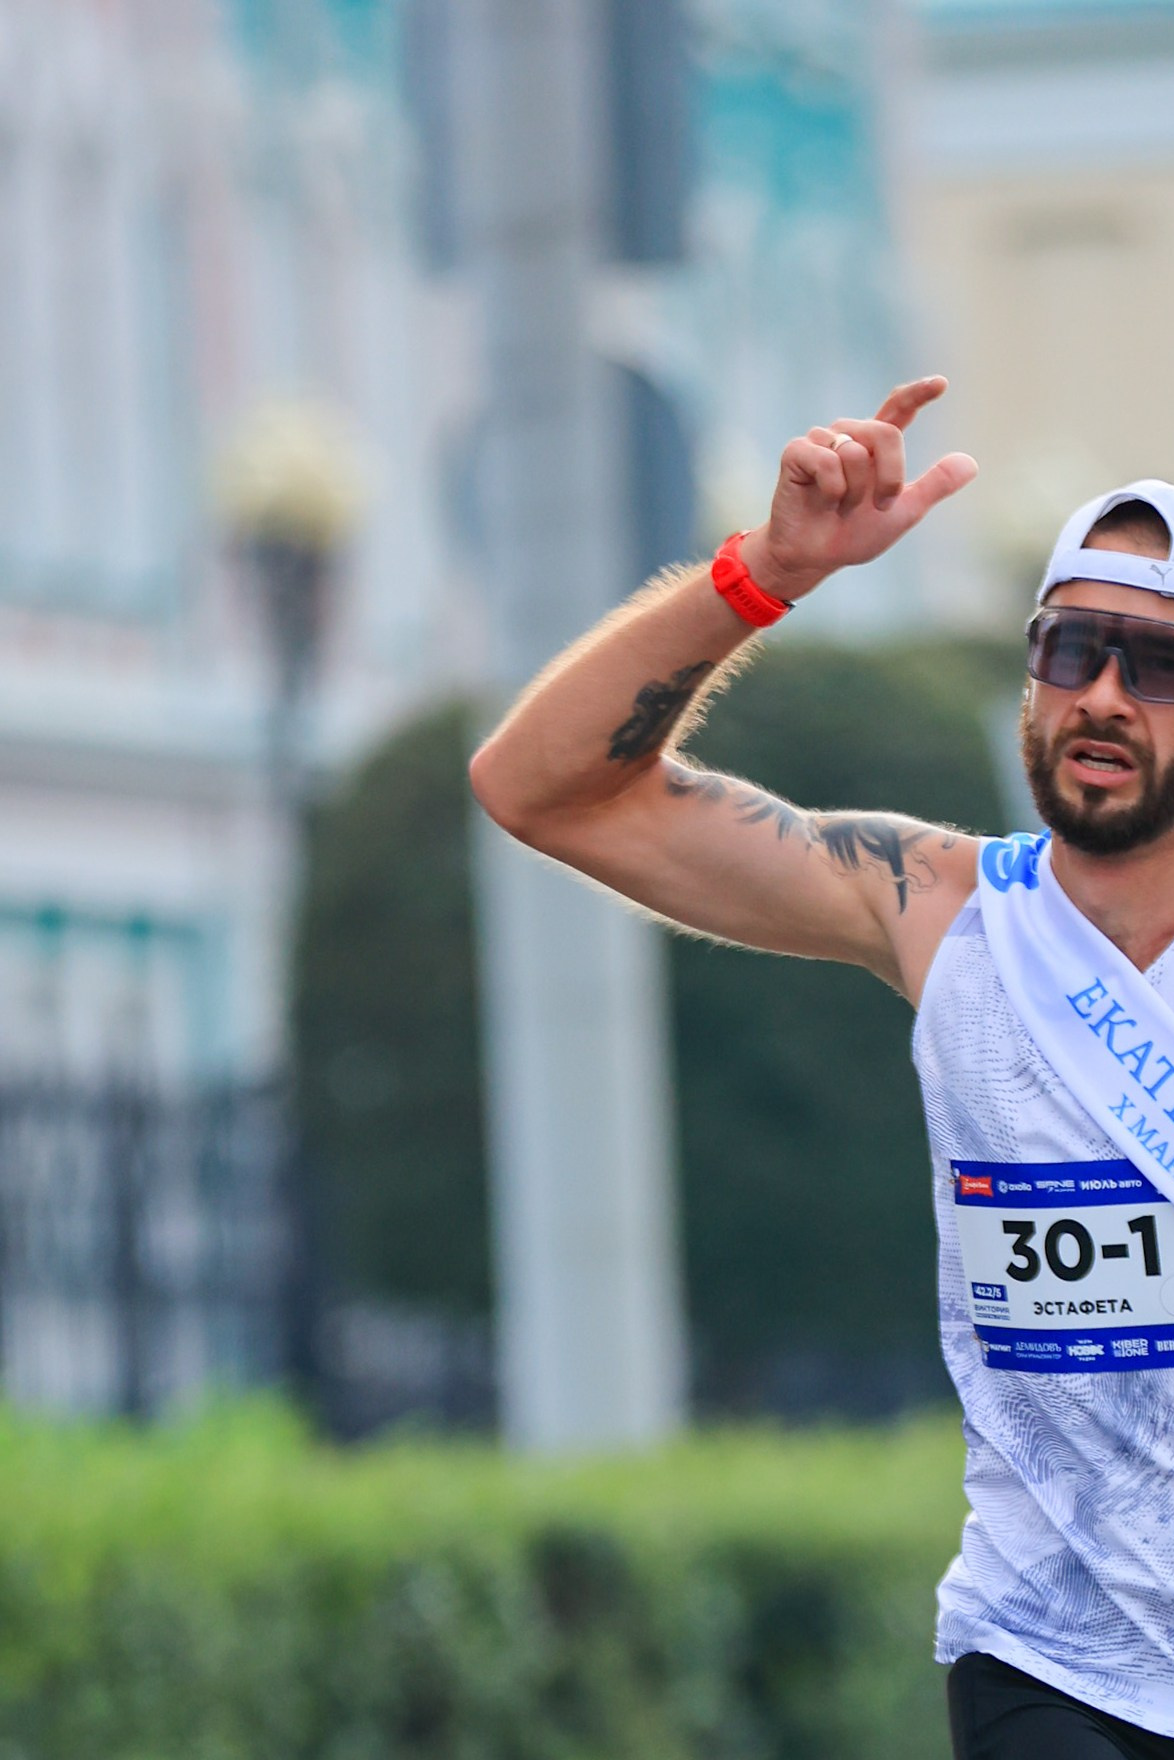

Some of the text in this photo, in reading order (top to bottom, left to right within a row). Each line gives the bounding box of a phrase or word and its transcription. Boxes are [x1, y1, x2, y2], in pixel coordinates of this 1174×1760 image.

[1081, 1180, 1118, 1191] ИЮЛЬ
[1002, 1215, 1162, 1282] 30-1
[975, 1285, 1002, 1299] 42.2/5
[1033, 1299, 1133, 1316] ЭСТАФЕТА
[1111, 1338, 1149, 1350] KIBER
